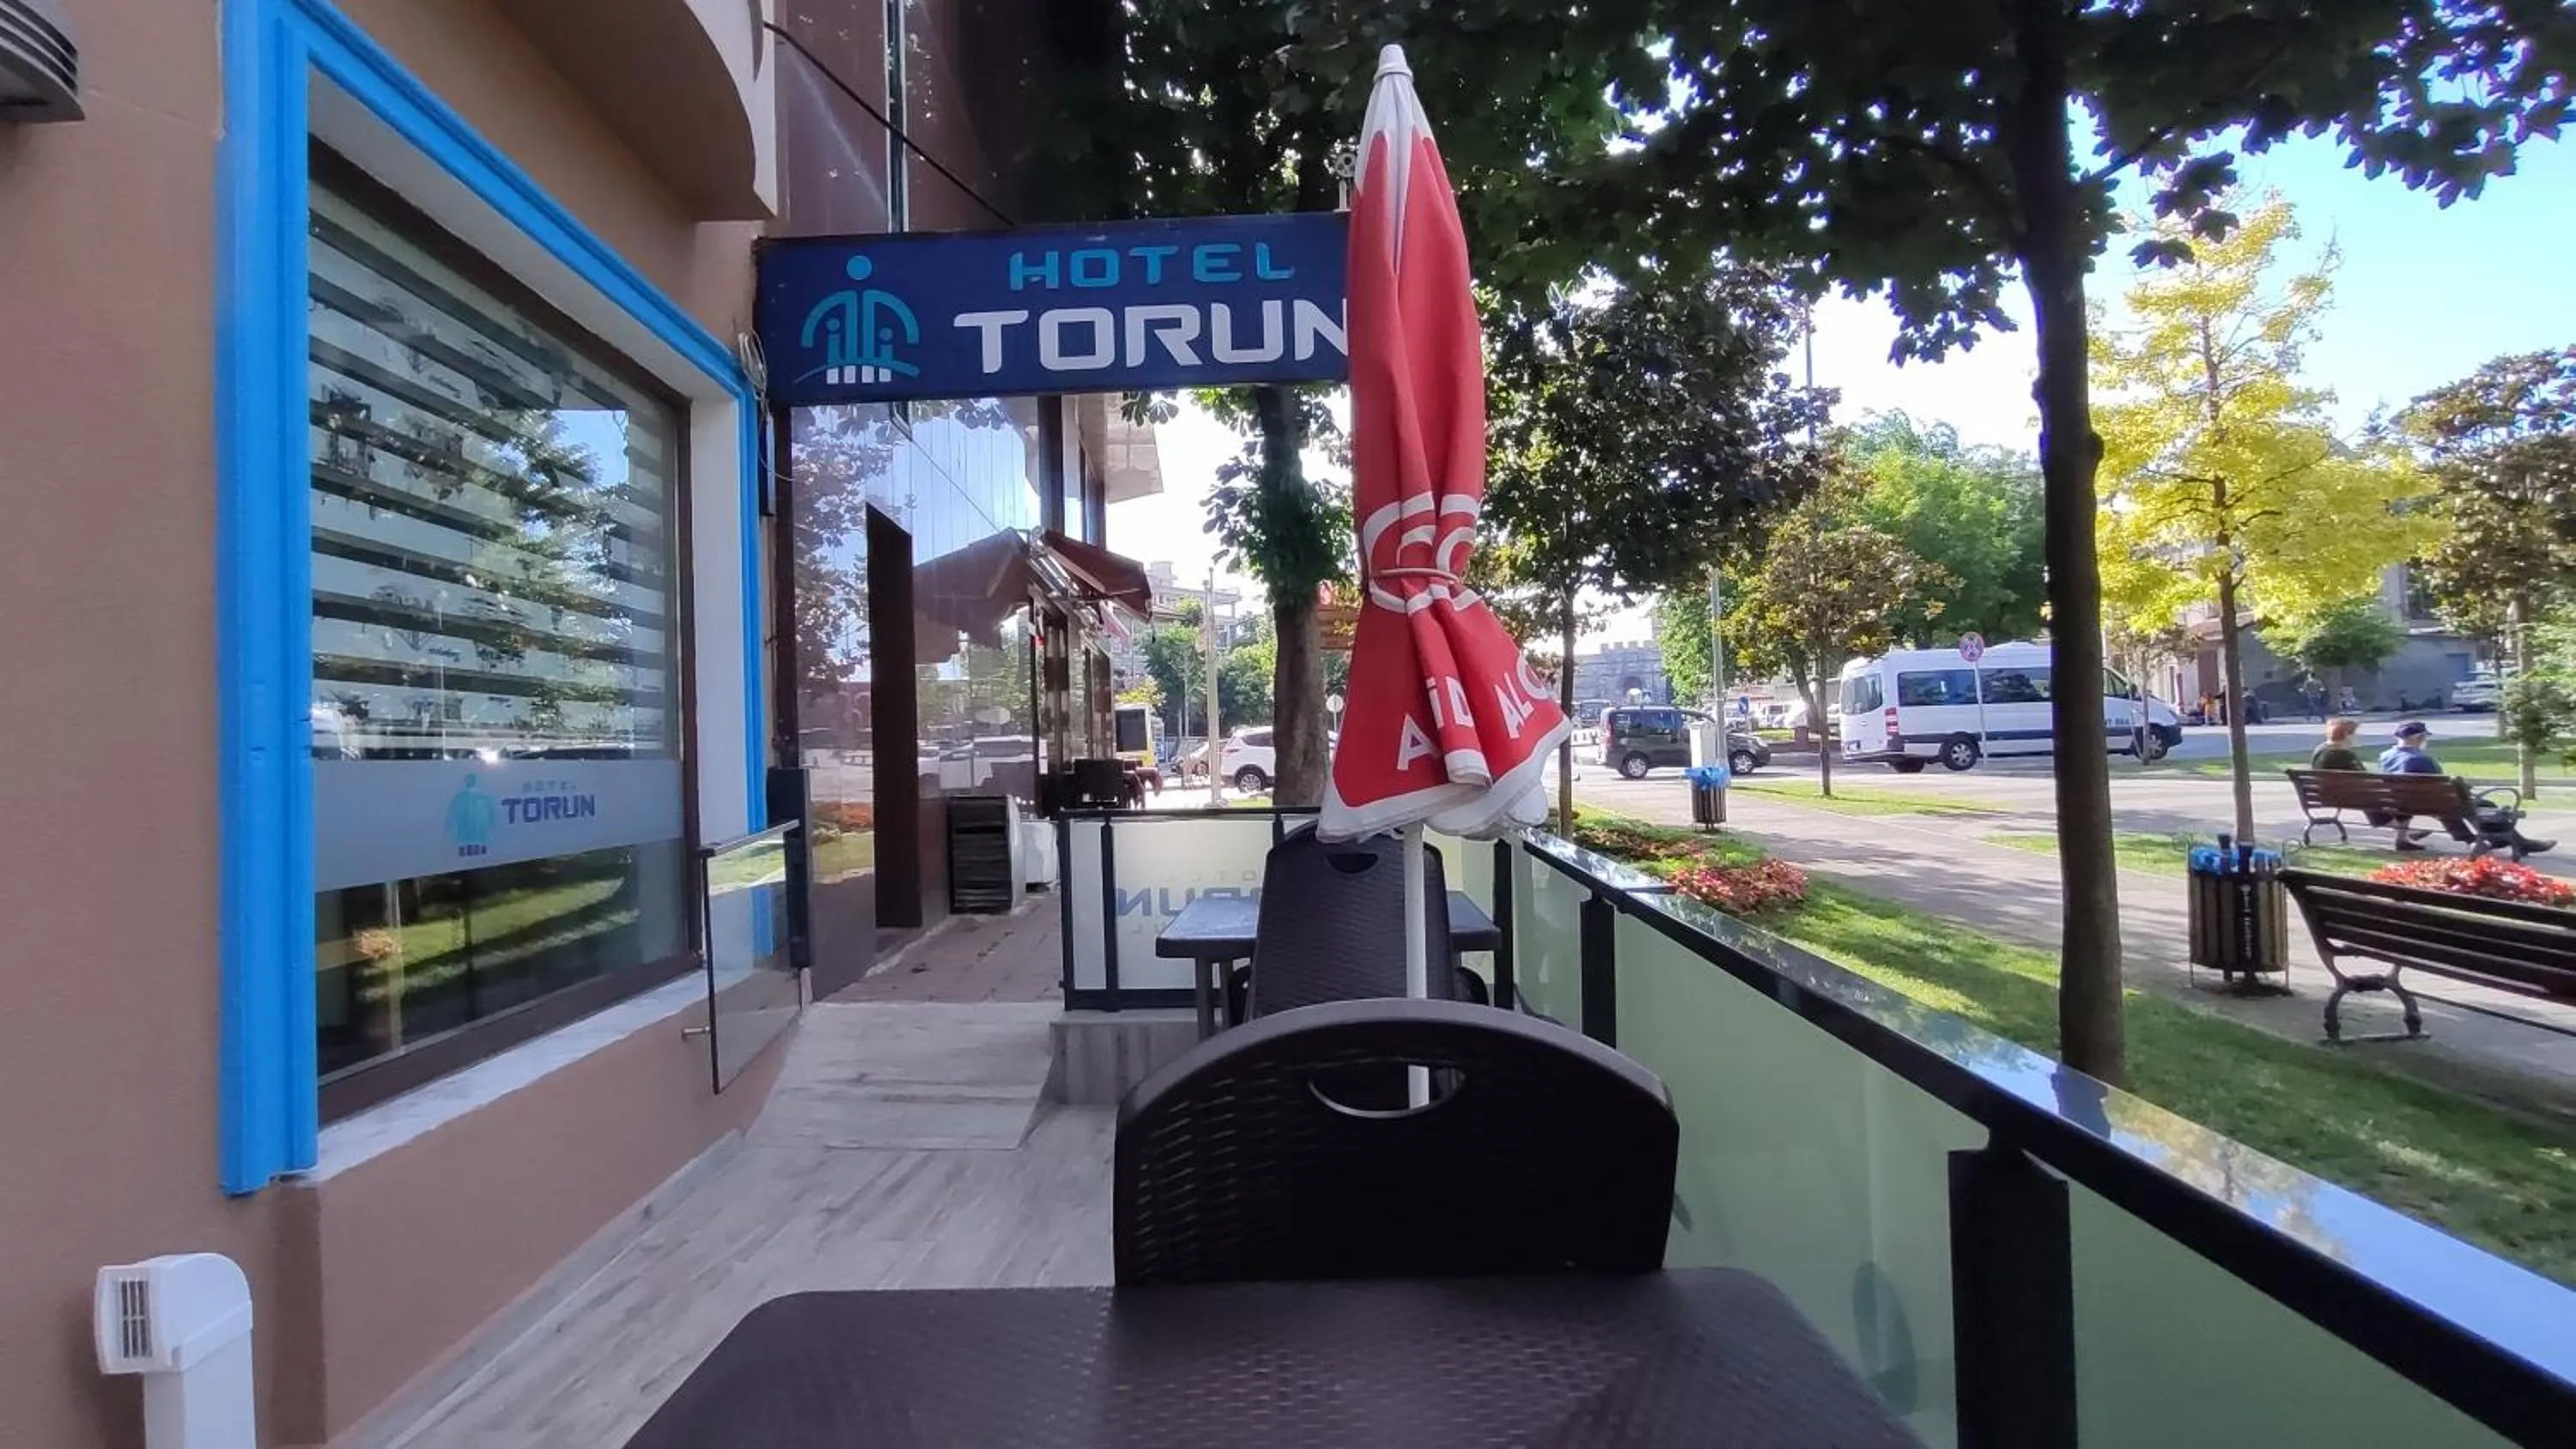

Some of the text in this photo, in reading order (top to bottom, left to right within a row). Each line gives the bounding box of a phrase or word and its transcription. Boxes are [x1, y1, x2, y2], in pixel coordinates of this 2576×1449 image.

[1009, 243, 1295, 290] HOTEL
[953, 298, 1348, 373] TORUN
[501, 794, 596, 824] TORUN
